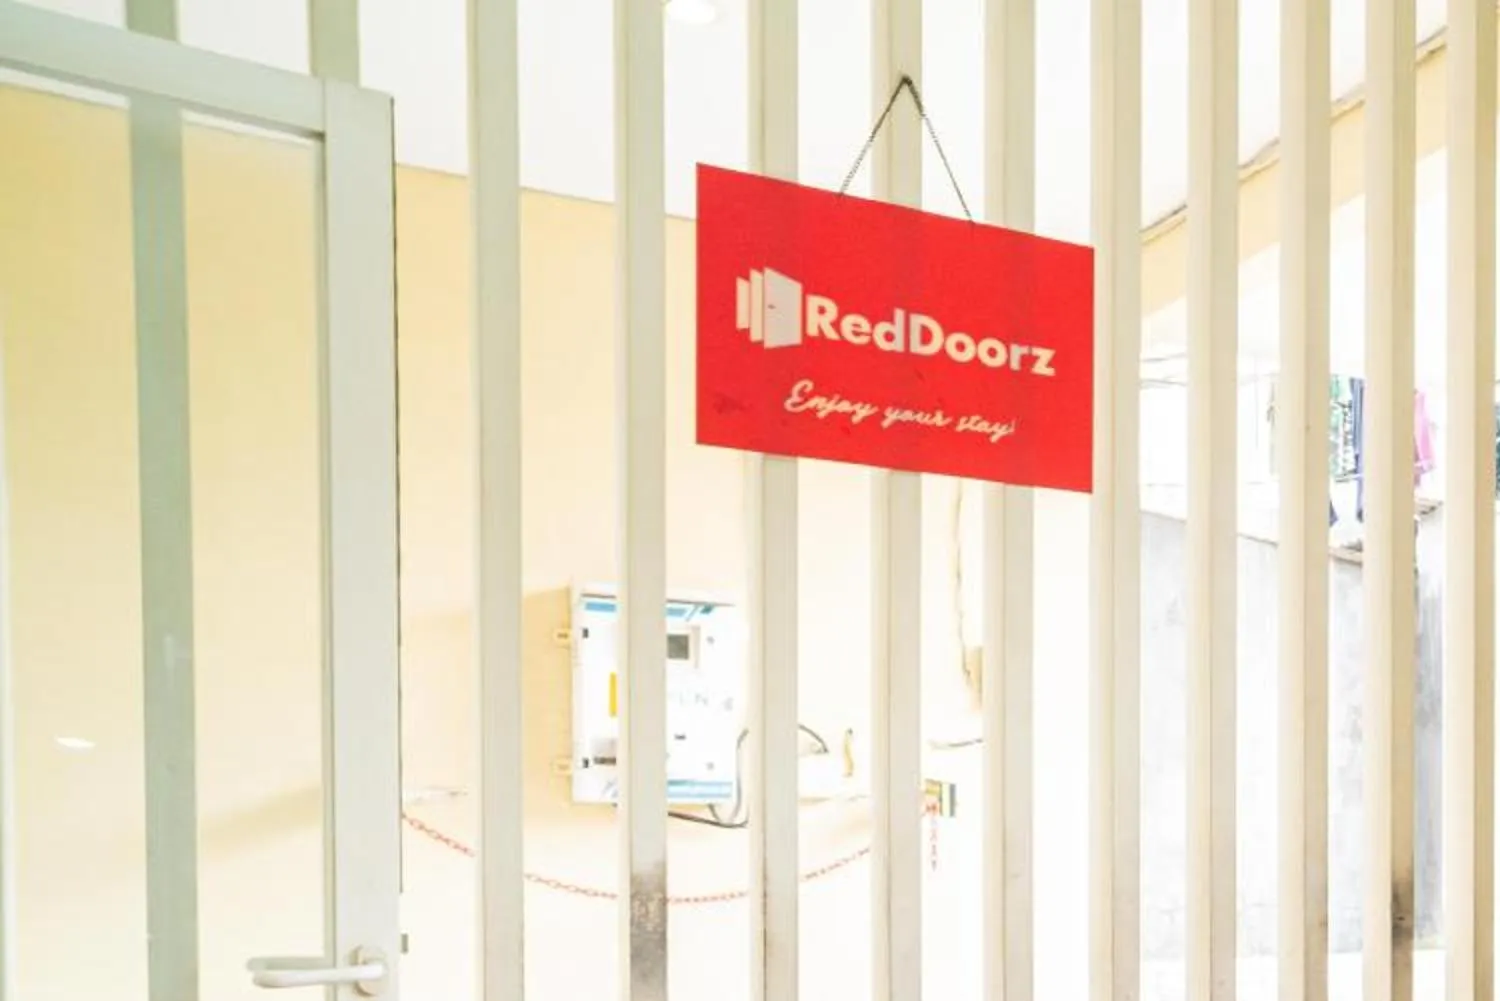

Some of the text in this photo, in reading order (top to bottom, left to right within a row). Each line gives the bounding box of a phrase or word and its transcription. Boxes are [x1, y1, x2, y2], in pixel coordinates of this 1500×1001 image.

[805, 294, 1056, 377] RedDoorz
[783, 379, 879, 424] Enjoy
[880, 406, 953, 429] your
